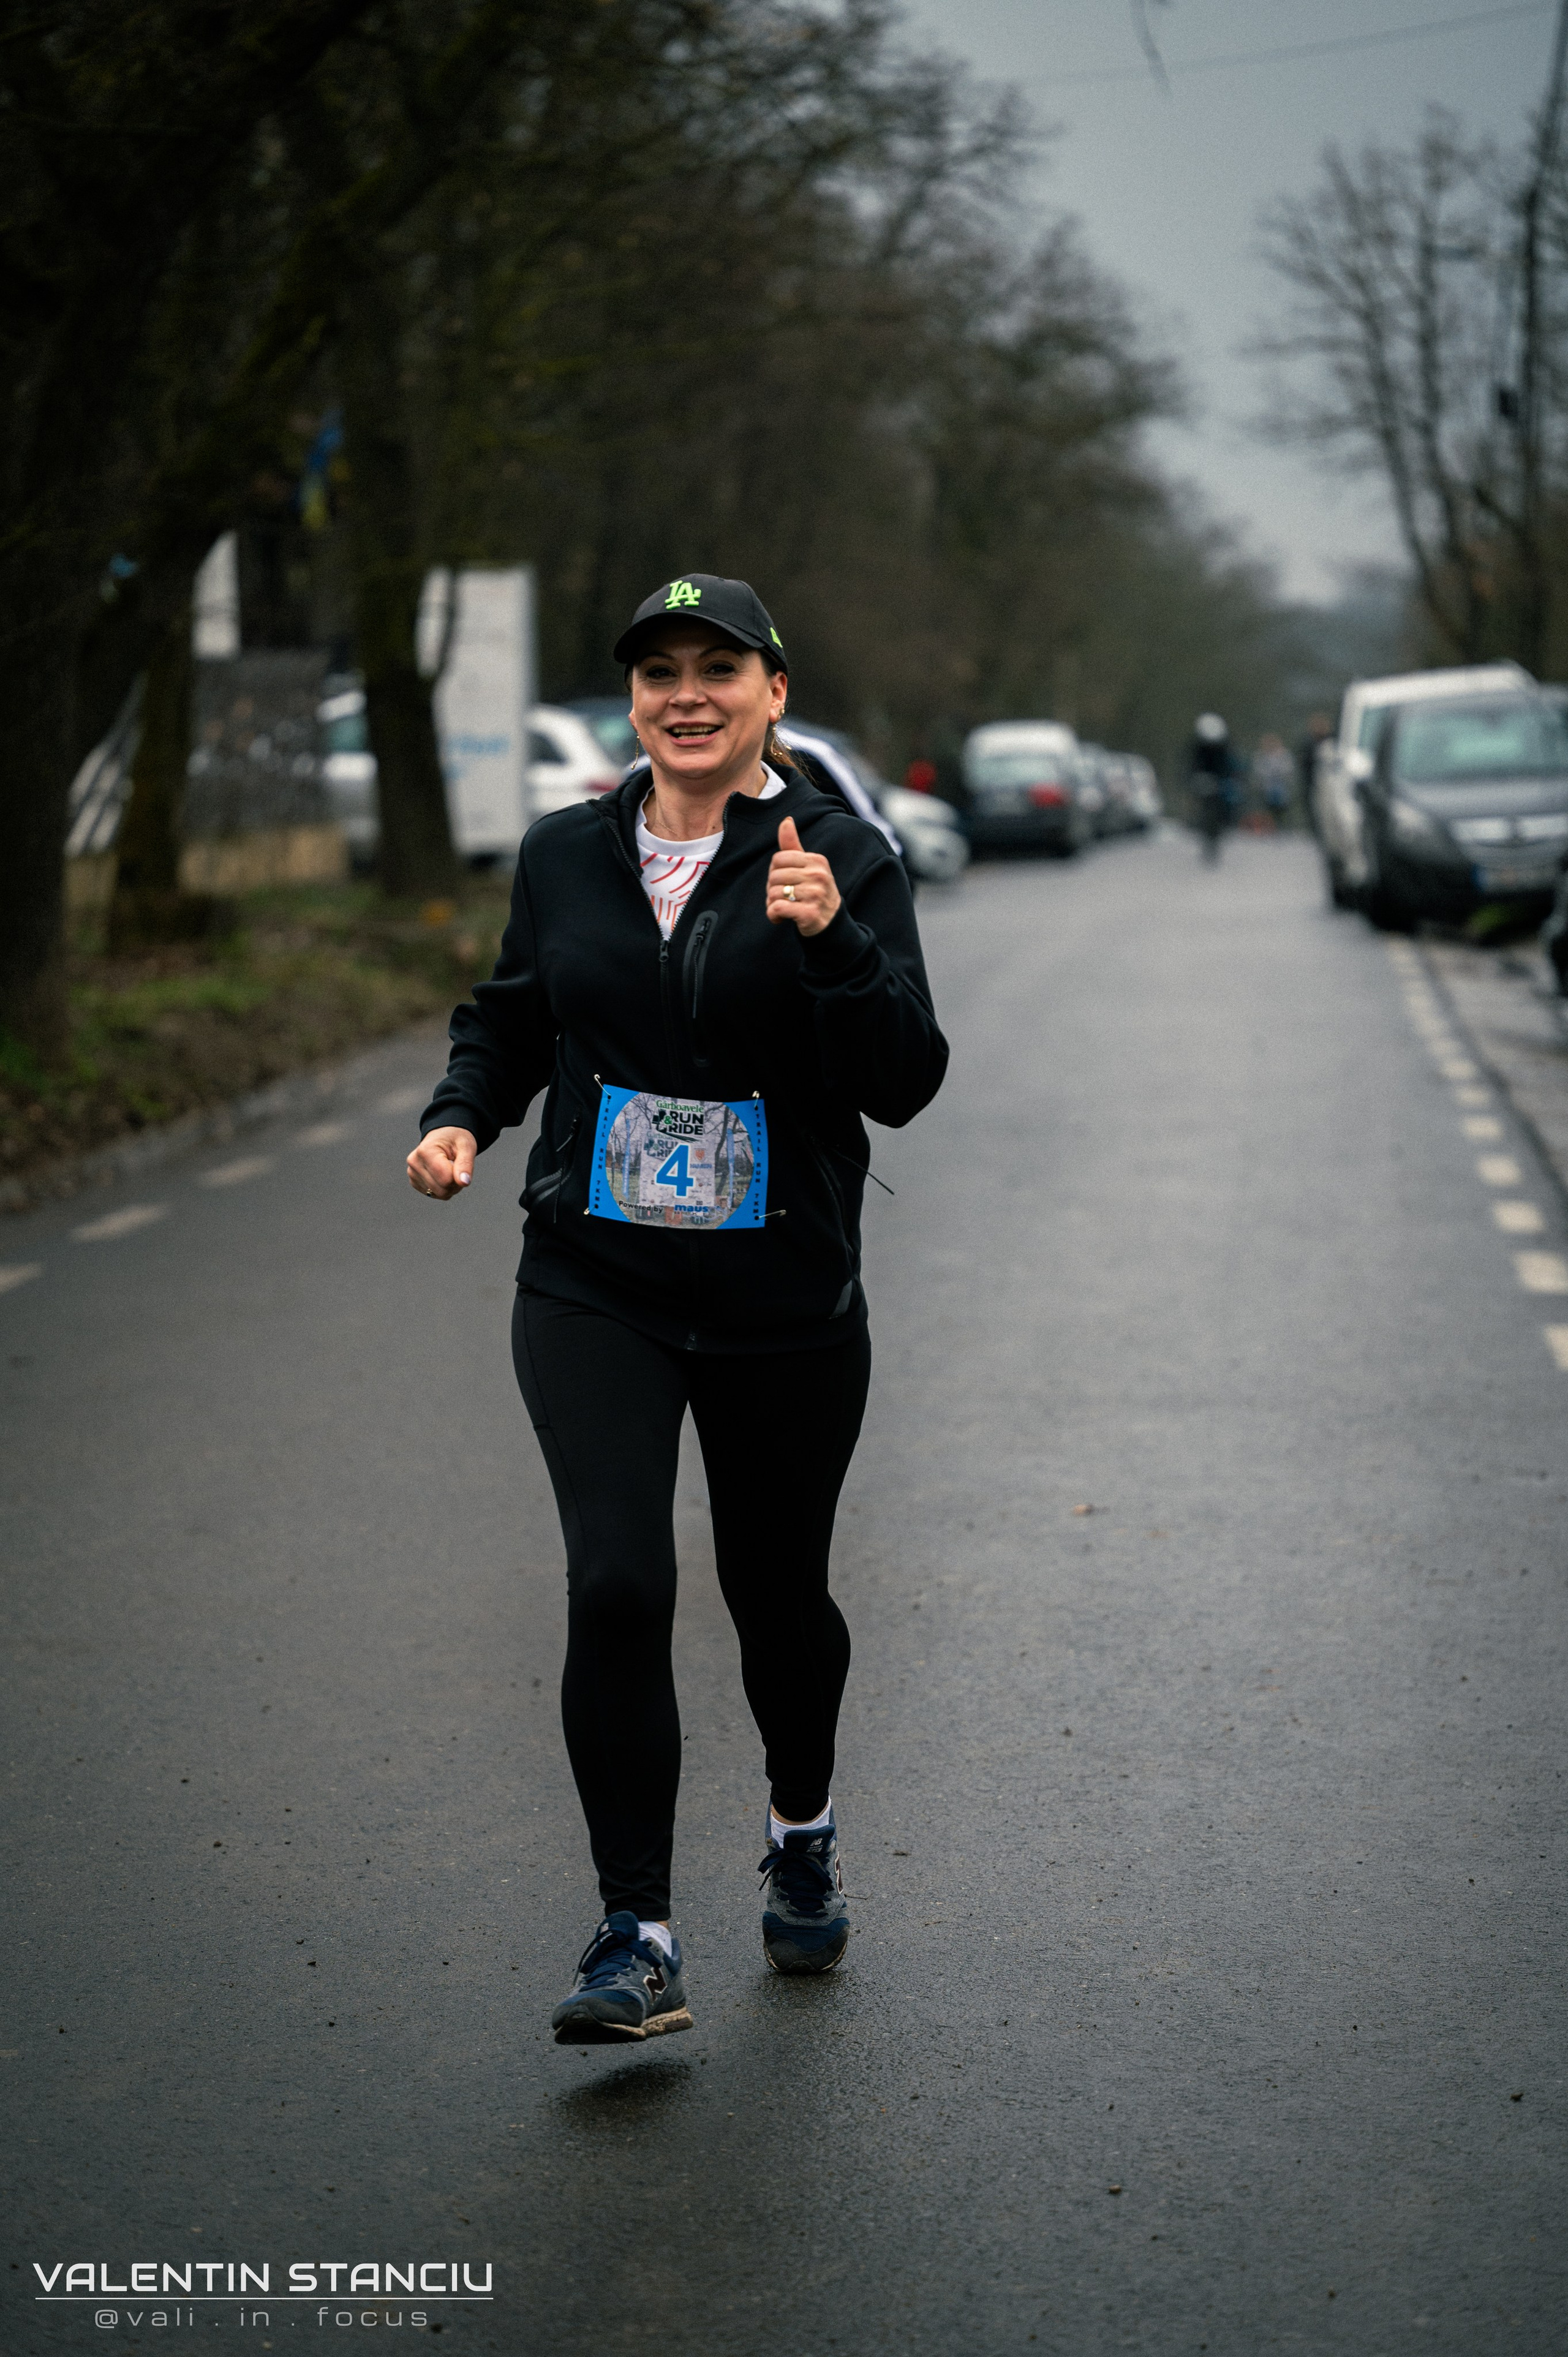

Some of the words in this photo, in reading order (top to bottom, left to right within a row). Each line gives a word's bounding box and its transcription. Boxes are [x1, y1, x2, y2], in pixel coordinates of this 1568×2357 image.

[665, 580, 701, 610] LA
[656, 1099, 704, 1112] Gârboavele
[602, 1100, 611, 1137] TRAIL
[664, 1115, 673, 1125] &
[669, 1110, 704, 1125] RUN
[668, 1123, 703, 1135] RIDE
[656, 1144, 694, 1196] 4
[619, 1201, 651, 1211] Powered
